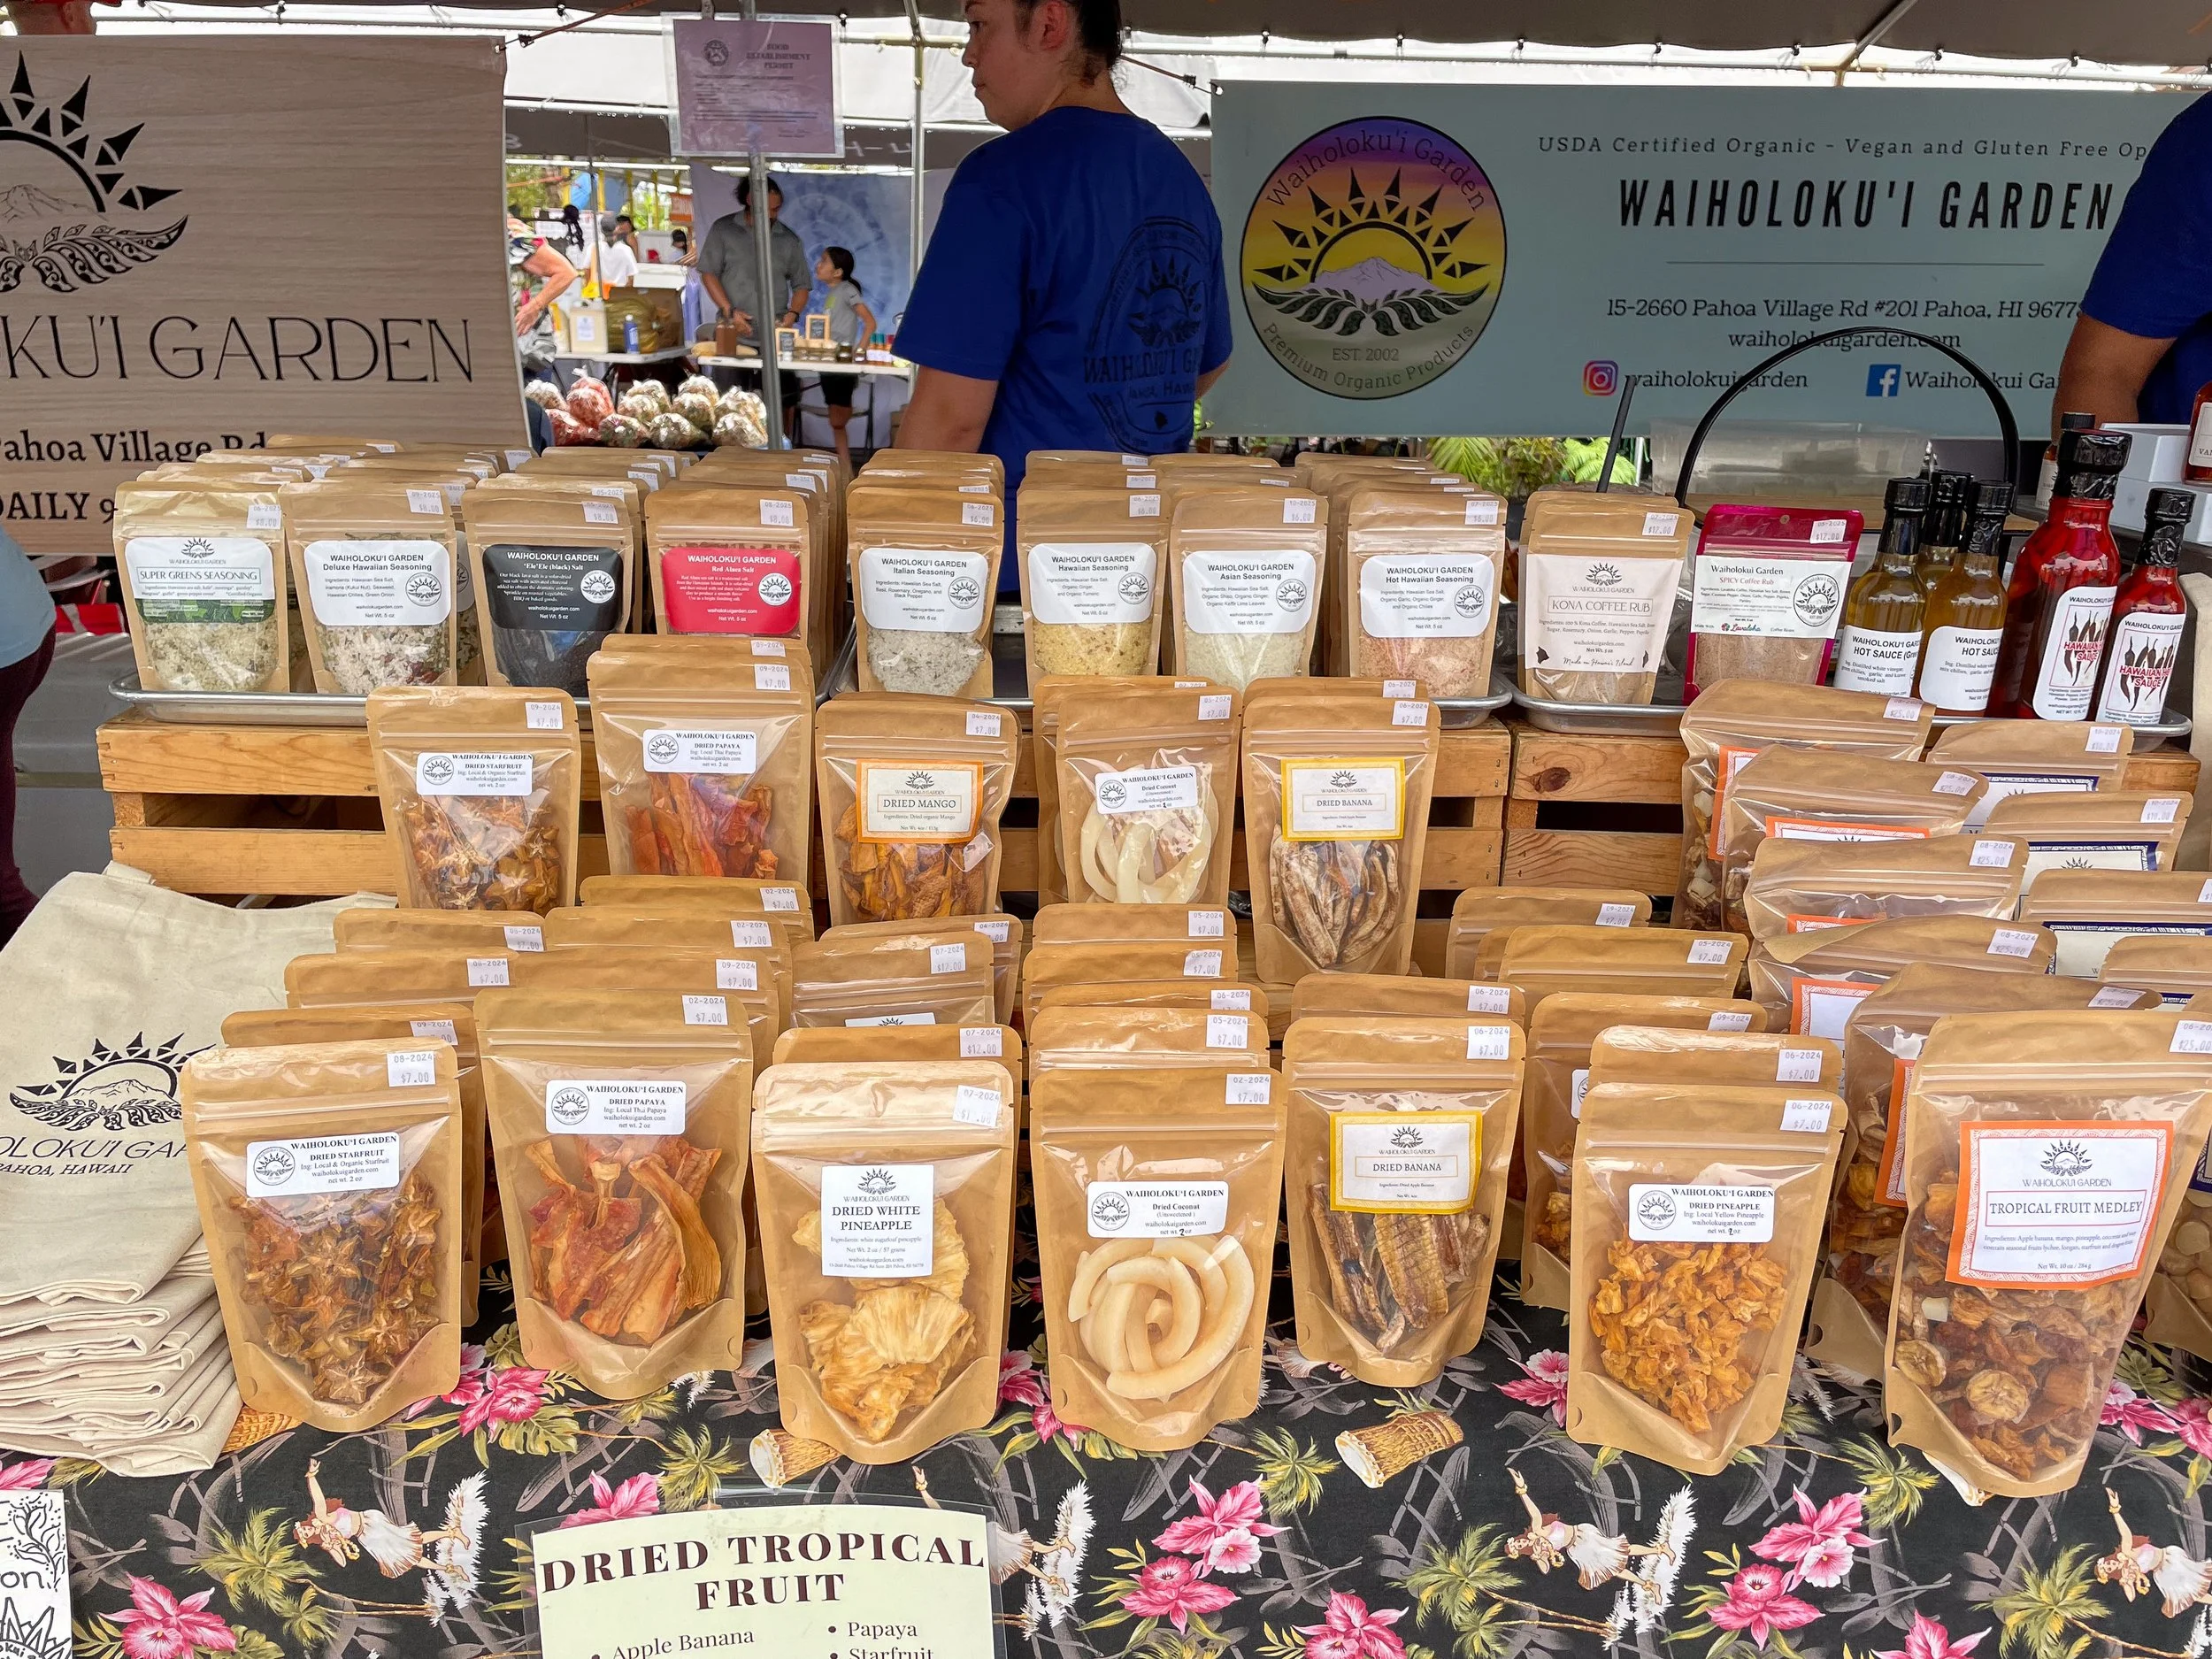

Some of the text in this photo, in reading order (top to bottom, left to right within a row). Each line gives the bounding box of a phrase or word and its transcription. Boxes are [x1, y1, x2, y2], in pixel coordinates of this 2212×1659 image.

[1538, 136, 1603, 152] USDA
[1612, 137, 1715, 154] Certified
[1723, 139, 1814, 158] Organic
[1842, 140, 1911, 159] Vegan
[1921, 141, 1962, 156] and
[1971, 141, 2047, 157] Gluten
[2056, 142, 2108, 157] Free
[1265, 129, 1486, 212] Waiholoku'i Garden
[1618, 180, 2113, 229] WAIHOLOKU'I GARDEN
[1607, 299, 1686, 317] 15-2660
[1692, 299, 1755, 317] Pahoa
[1763, 300, 1833, 322] Village
[1839, 300, 1868, 318] Rd
[1874, 301, 1917, 318] #201
[1922, 301, 1991, 321] Pahoa,
[1997, 302, 2023, 319] HI
[149, 316, 473, 384] GARDEN
[1366, 348, 1399, 361] 2002
[1263, 322, 1329, 382] Premium
[1333, 369, 1402, 392] Organic
[1405, 324, 1474, 378] Products
[1905, 372, 2023, 389] Waiholkui
[0, 430, 87, 462] ahoa
[90, 430, 212, 462] Village
[0, 492, 90, 520] AILY
[741, 556, 776, 565] GARDEN
[389, 564, 432, 572] Seasoning
[916, 568, 955, 578] Seasoning
[1711, 565, 1784, 575] Waiholokui Garden
[140, 570, 257, 580] SUPER GREENS SEASONING
[1435, 576, 1474, 585] Seasoning
[1552, 600, 1650, 612] KONA COFFEE RUB
[1853, 646, 1902, 658] HOT SAUCE
[2119, 665, 2161, 677] HAWAIIAN
[764, 680, 786, 688] $7.00
[2134, 678, 2162, 687] SAUCE
[536, 718, 559, 727] $7.00
[883, 799, 956, 808] DRIED MANGO
[1341, 798, 1372, 807] BANANA
[1977, 855, 2005, 865] $25.00
[688, 996, 726, 1005] 02-2024
[695, 1011, 722, 1023] $7.00
[1217, 1035, 1242, 1047] $7.00
[967, 1042, 996, 1055] $12.00
[394, 1054, 434, 1063] 08-2024
[401, 1071, 430, 1083] $7.00
[648, 1086, 683, 1094] GARDEN
[1238, 1092, 1265, 1102] $7.00
[1792, 1102, 1830, 1111] 06-2024
[1794, 1118, 1822, 1129] $7.00
[357, 1136, 396, 1146] GARDEN
[310, 1148, 384, 1161] DRIED STARFRUIT
[60, 1164, 134, 1174] HAWAII
[301, 1162, 311, 1172] Ing:
[313, 1161, 331, 1170] Local
[340, 1159, 363, 1170] Organic
[365, 1157, 389, 1166] Starfruit
[311, 1166, 379, 1179] waiholokuigarden.com
[832, 1206, 920, 1216] DRIED WHITE
[1990, 1202, 2142, 1214] TROPICAL FRUIT MEDLEY
[841, 1221, 912, 1230] PINEAPPLE
[540, 1532, 985, 1594] DRIED TROPICAL
[695, 1573, 846, 1611] FRUIT
[848, 1622, 918, 1640] Papaya
[613, 1629, 755, 1659] Apple Banana
